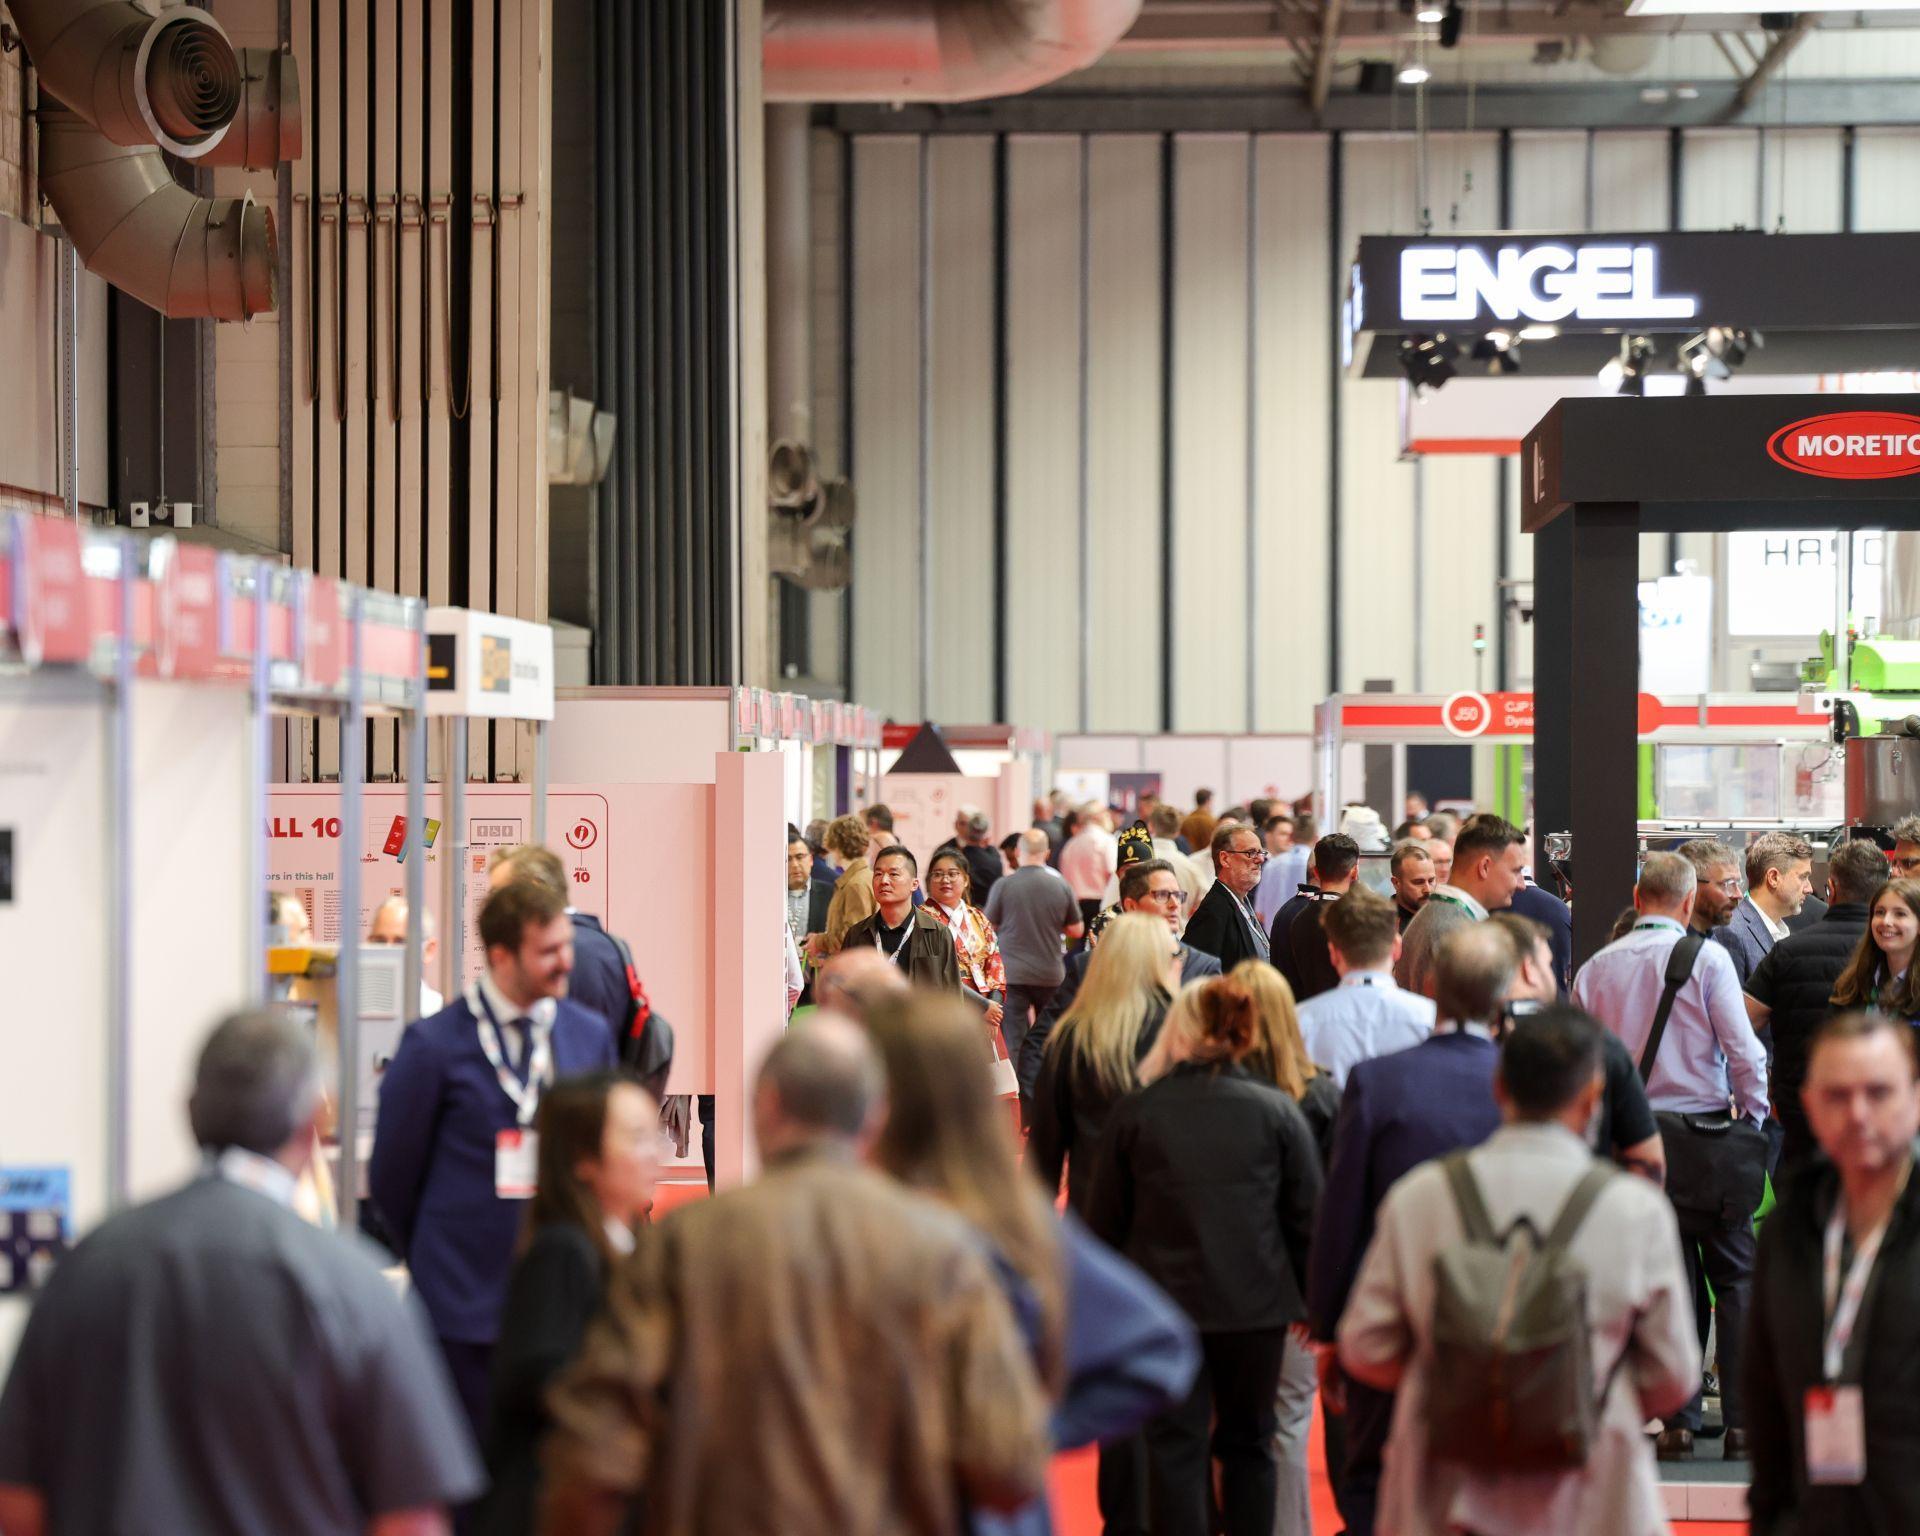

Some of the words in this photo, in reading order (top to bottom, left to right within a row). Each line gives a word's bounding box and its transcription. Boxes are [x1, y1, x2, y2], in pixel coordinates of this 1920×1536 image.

[1400, 246, 1696, 322] ENGEL
[1454, 706, 1479, 722] J50
[311, 817, 344, 838] 10
[284, 872, 292, 880] in
[295, 872, 314, 880] this
[316, 872, 334, 880] hall
[573, 872, 590, 883] 10
